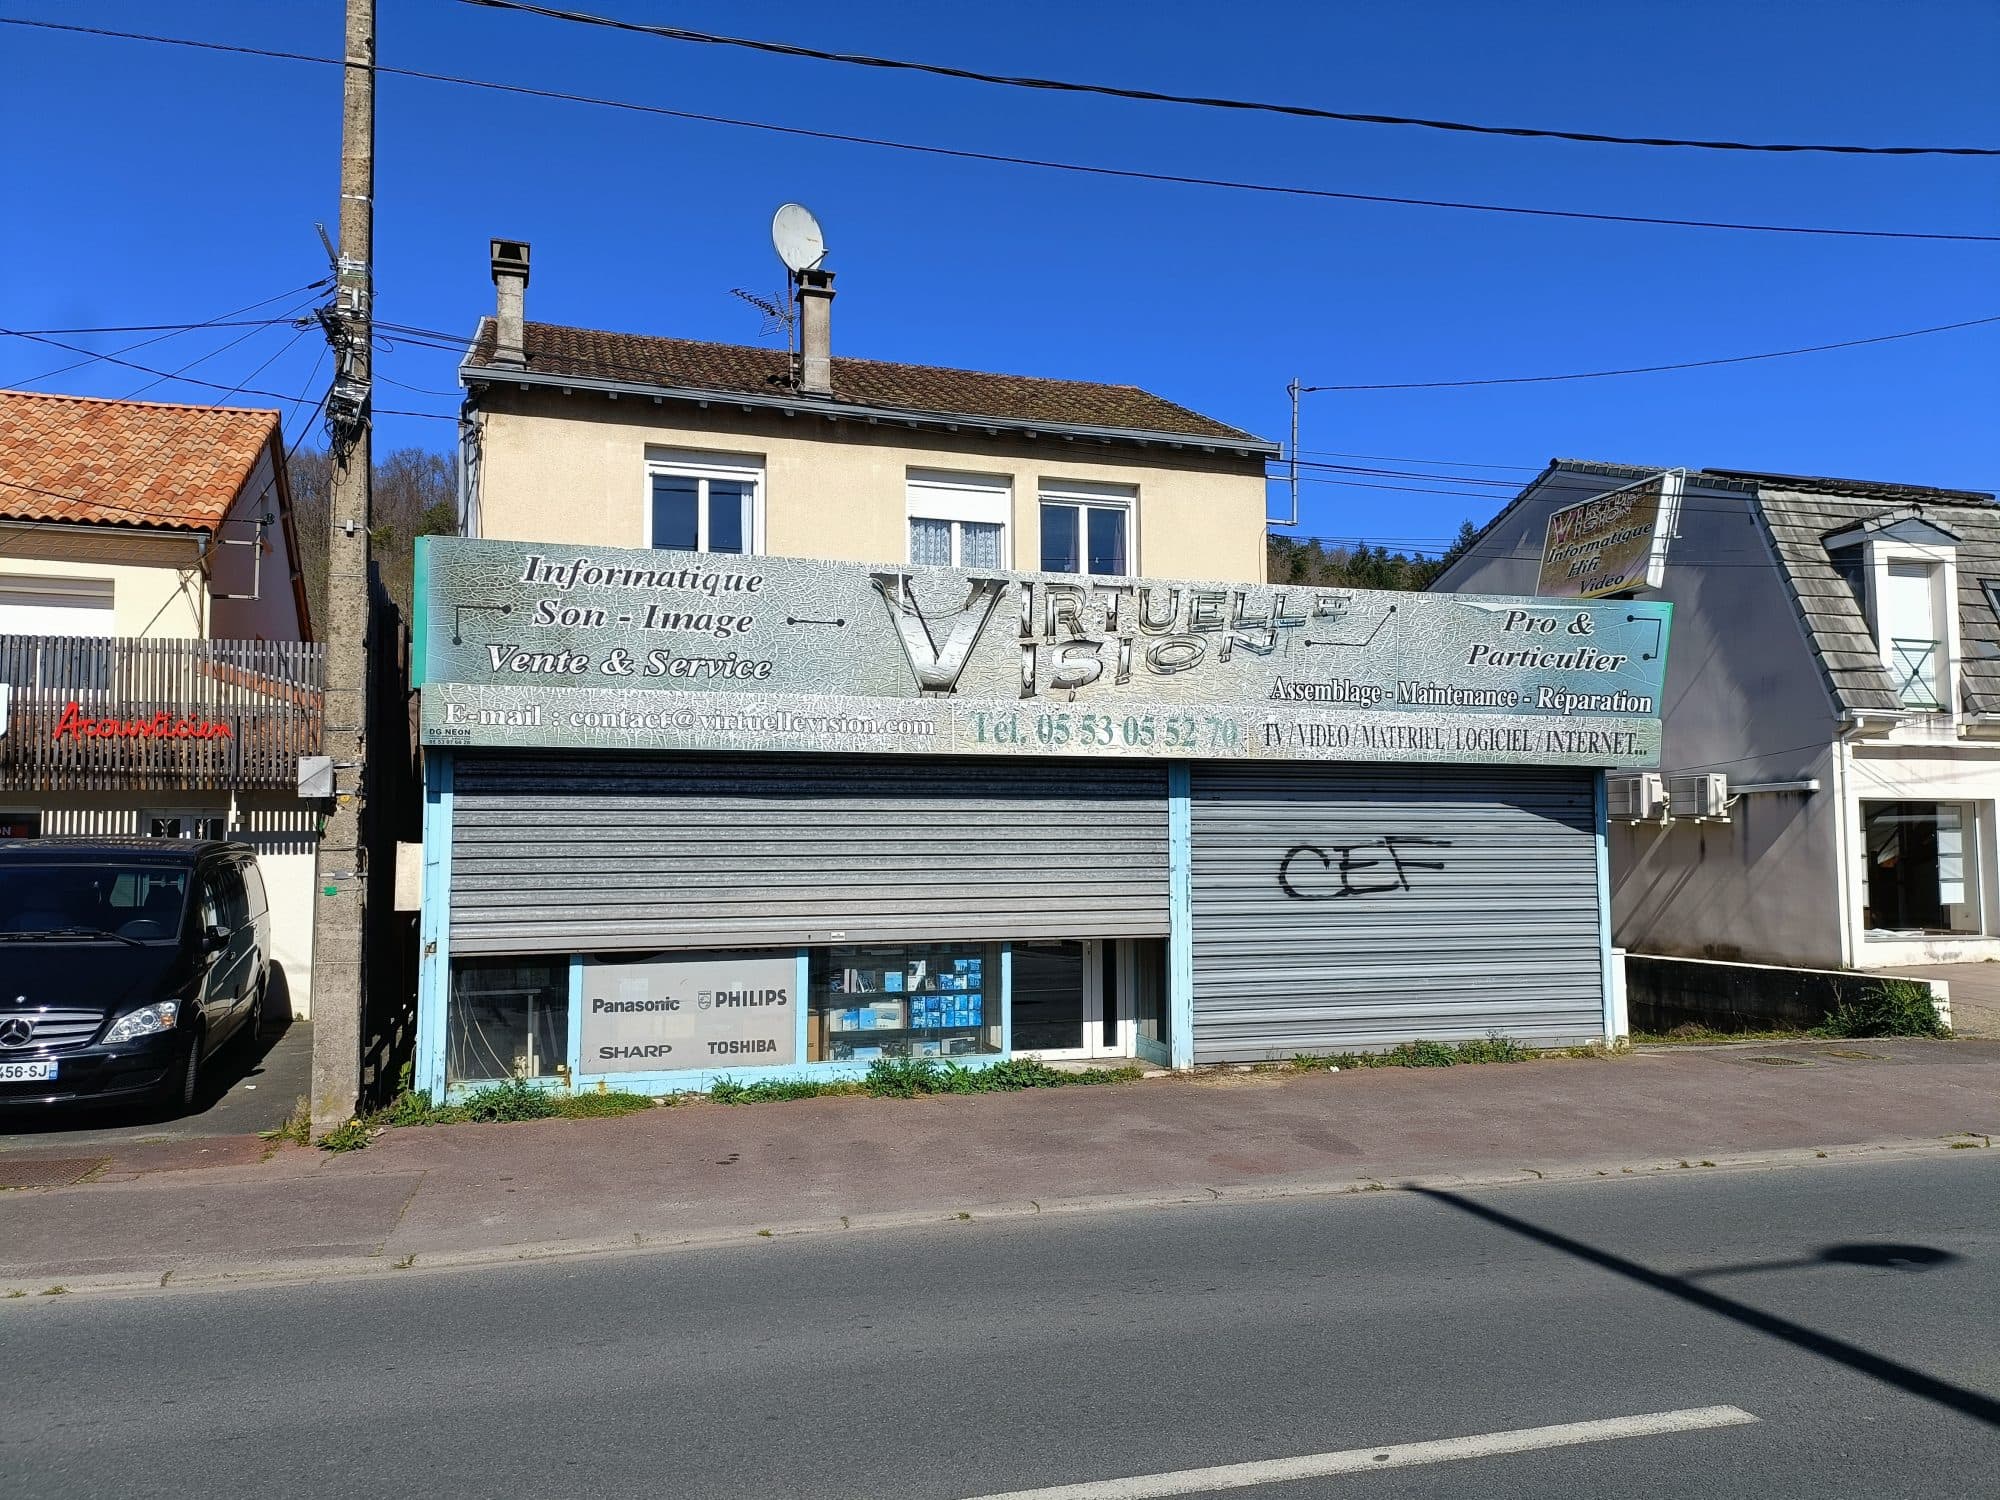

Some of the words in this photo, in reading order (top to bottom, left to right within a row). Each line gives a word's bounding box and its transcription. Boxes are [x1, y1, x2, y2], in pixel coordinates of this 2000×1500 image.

[1547, 522, 1653, 564] Informatique
[523, 556, 763, 597] Informatique
[1567, 556, 1601, 579] Hifi
[1579, 575, 1625, 594] Video
[534, 599, 605, 627] Son
[643, 604, 754, 638] Image
[1504, 610, 1557, 633] Pro
[1567, 613, 1594, 635] &
[486, 644, 589, 674] Vente
[600, 648, 634, 676] &
[643, 650, 773, 680] Service
[1466, 644, 1627, 671] Particulier
[1270, 676, 1382, 708] Assemblage
[1398, 681, 1518, 708] Maintenance
[1536, 686, 1652, 715] Réparation
[54, 701, 235, 740] Acousticien
[443, 703, 543, 727] E-mail
[569, 709, 937, 736] contact@virtuellevision.com
[970, 710, 1028, 745] Tél.
[1037, 713, 1070, 745] 05
[1081, 714, 1114, 747] 53
[1123, 715, 1155, 747] 05
[1164, 716, 1197, 747] 52
[1207, 716, 1239, 748] 70
[592, 996, 680, 1014] Panasonic
[715, 989, 787, 1008] PHILIPS
[599, 1044, 673, 1060] SHARP
[708, 1039, 777, 1055] TOSHIBA
